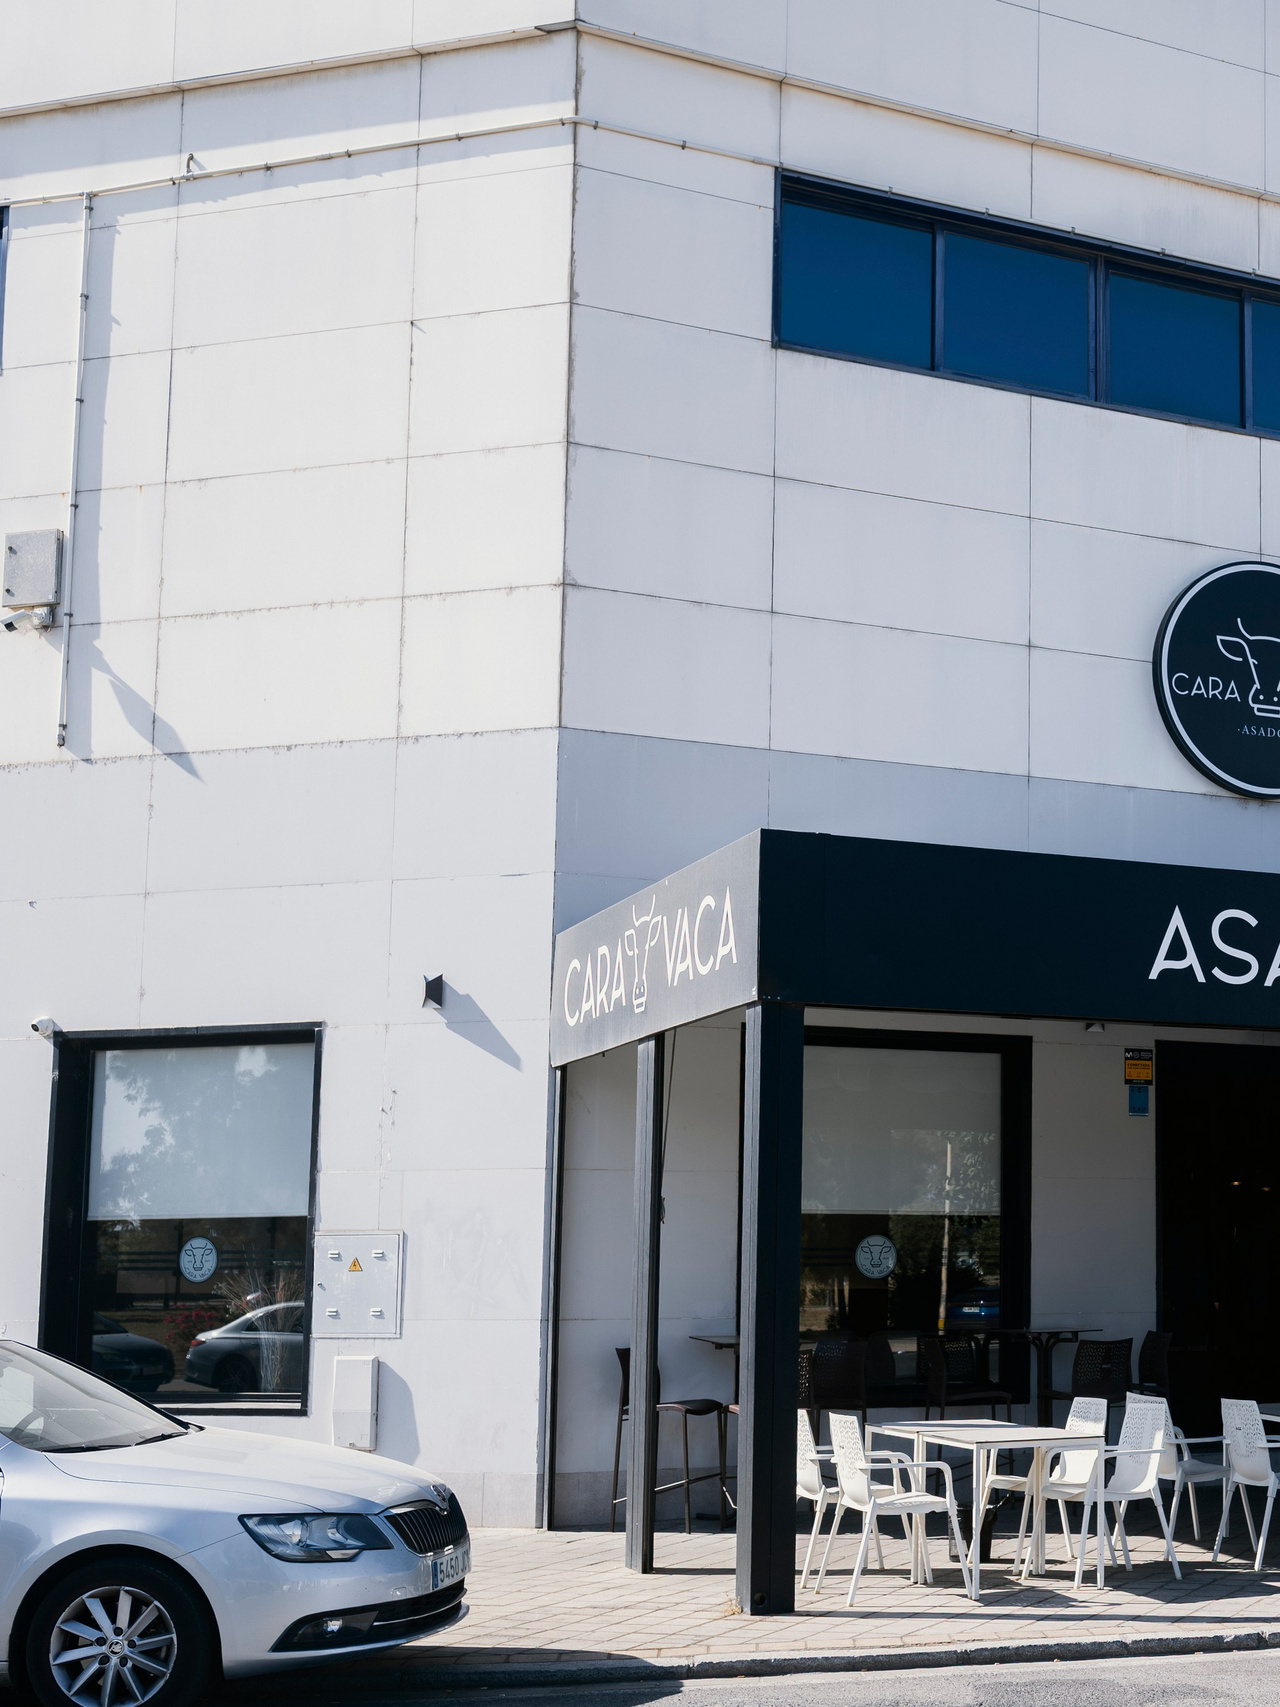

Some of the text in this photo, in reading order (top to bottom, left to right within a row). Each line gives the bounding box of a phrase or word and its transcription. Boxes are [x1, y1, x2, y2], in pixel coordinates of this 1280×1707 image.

[1171, 672, 1241, 702] CARA
[564, 886, 738, 1027] CARA VACA
[439, 1555, 460, 1583] 5450
